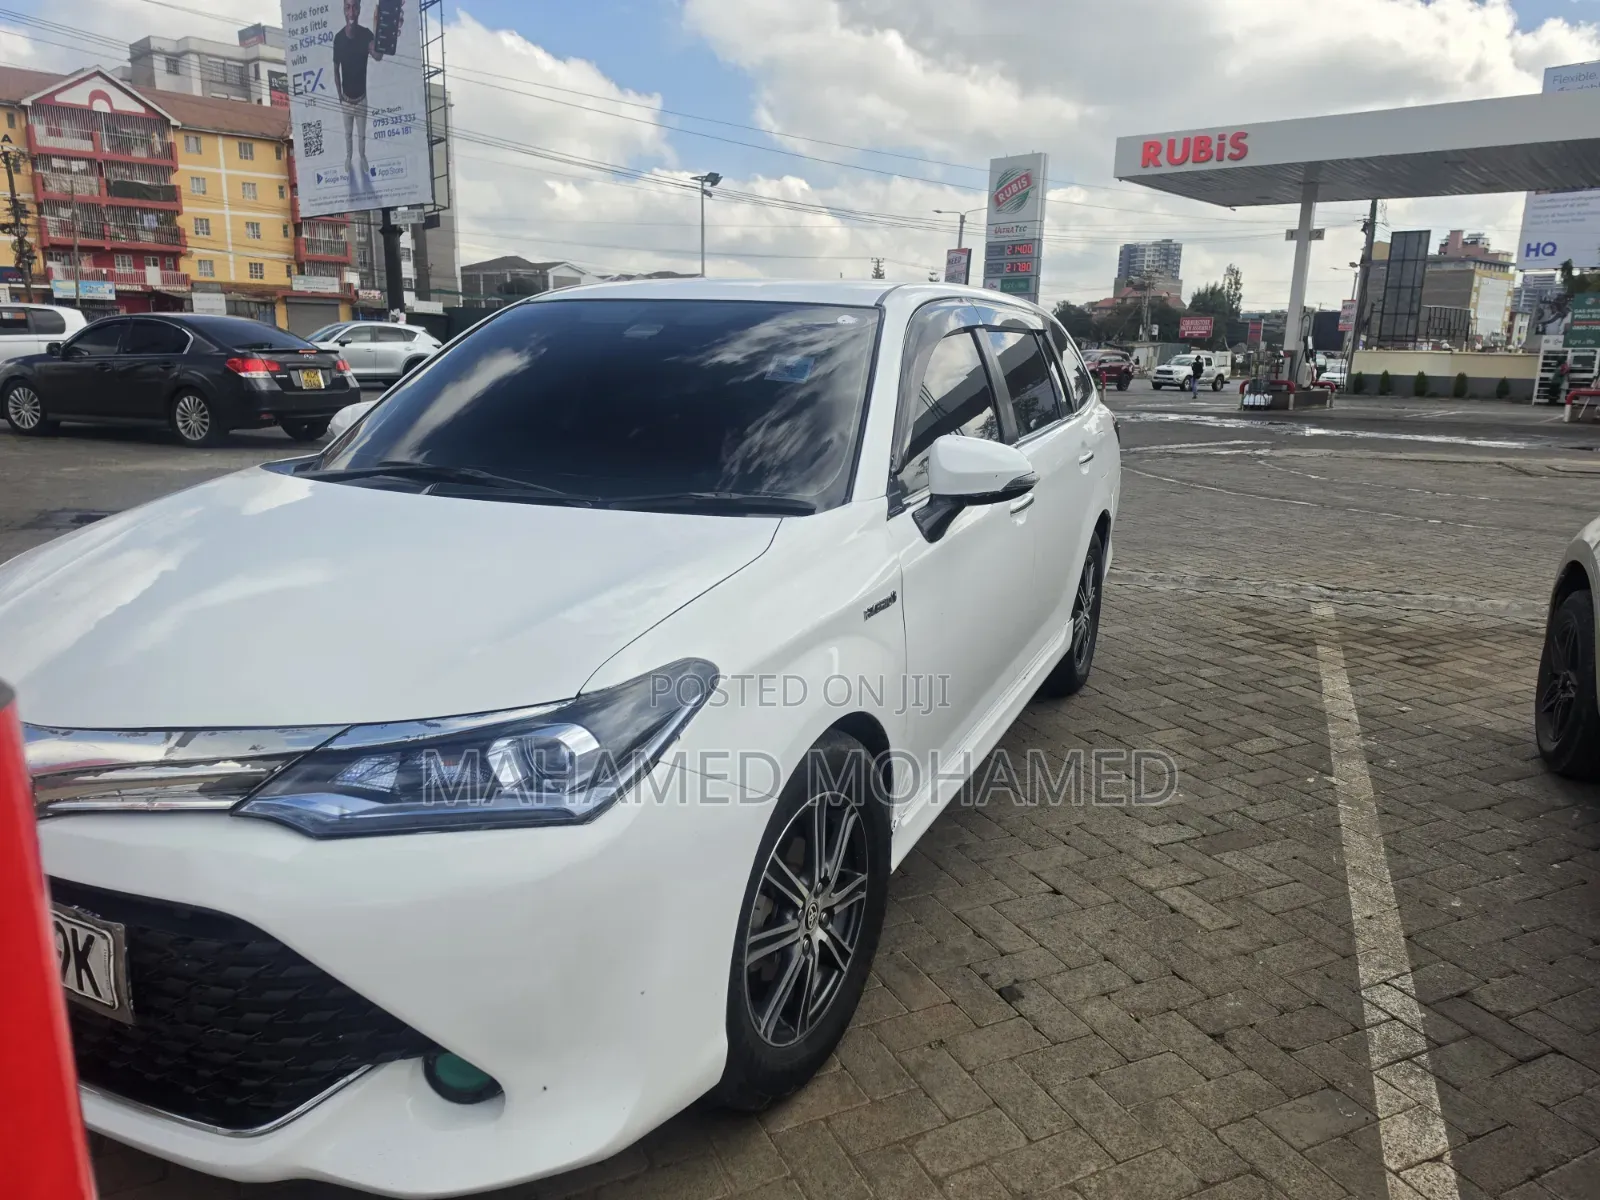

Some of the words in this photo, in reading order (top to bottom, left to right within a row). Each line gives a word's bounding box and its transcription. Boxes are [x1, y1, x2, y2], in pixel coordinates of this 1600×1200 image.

[286, 10, 307, 22] Trade
[309, 4, 329, 17] forex
[288, 28, 299, 37] for
[300, 25, 309, 35] as
[309, 18, 328, 31] little
[290, 43, 298, 52] as
[299, 35, 316, 48] KSH
[317, 31, 334, 44] 500
[291, 54, 308, 66] with
[293, 67, 326, 96] EFX
[998, 176, 1029, 203] RUBIS
[1315, 230, 1322, 239] 2
[1525, 241, 1557, 258] HQ
